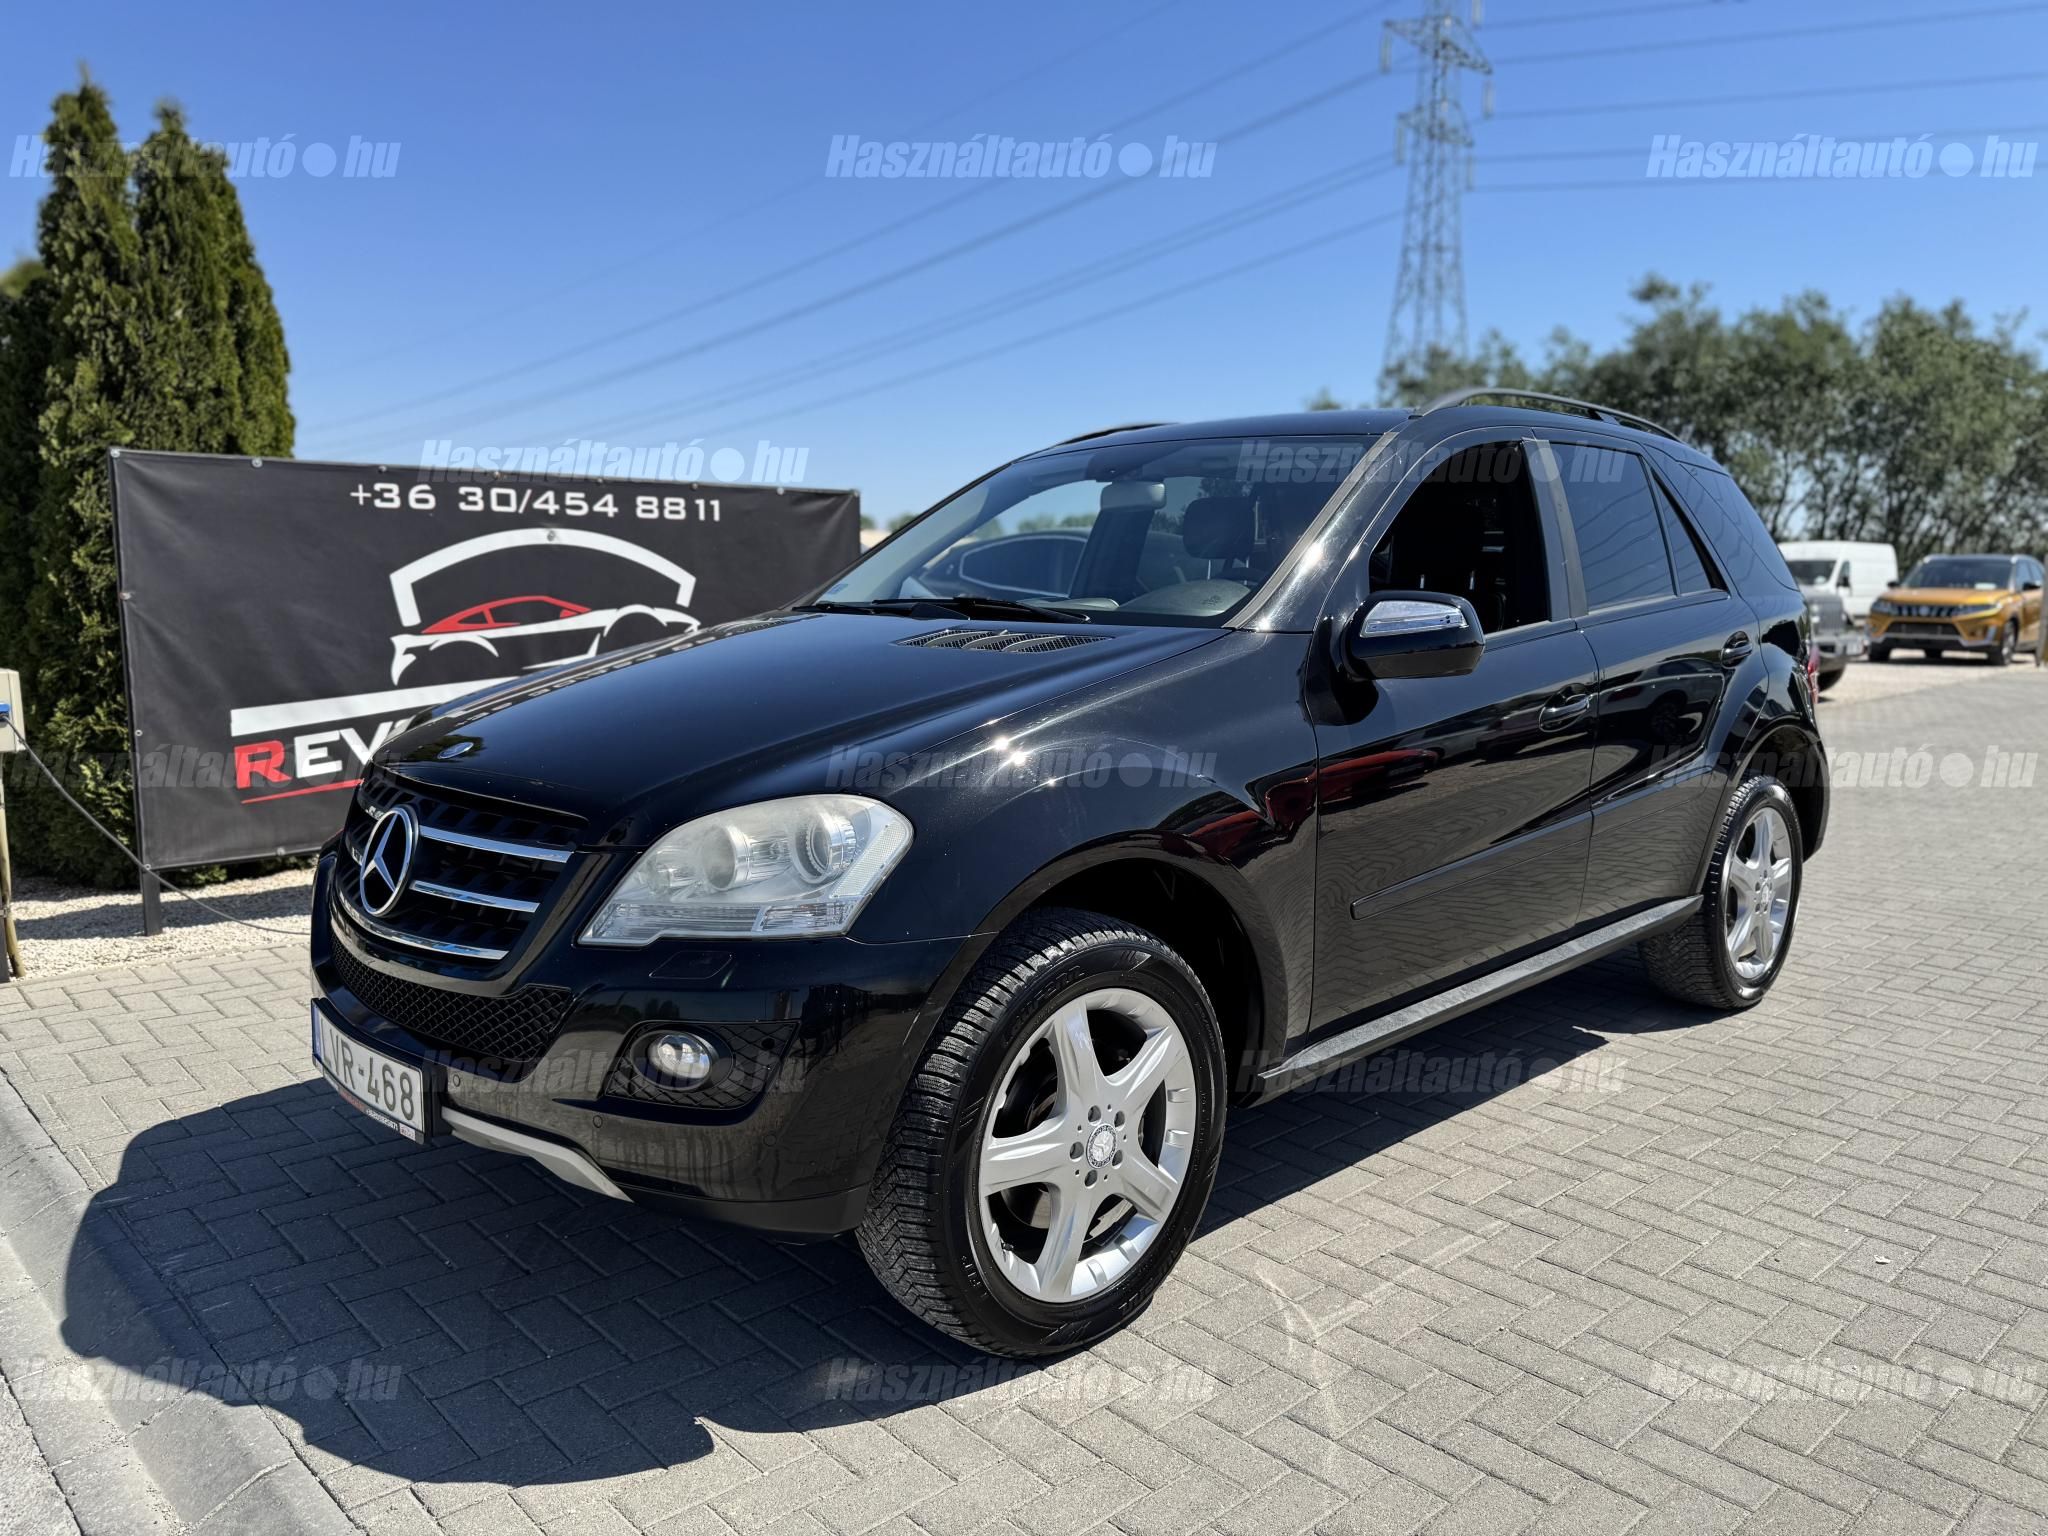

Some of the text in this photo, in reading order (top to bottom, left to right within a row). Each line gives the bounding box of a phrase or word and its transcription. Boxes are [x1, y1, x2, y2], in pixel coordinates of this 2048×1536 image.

[350, 483, 721, 522] +36 30/454 8811
[234, 714, 416, 790] REV
